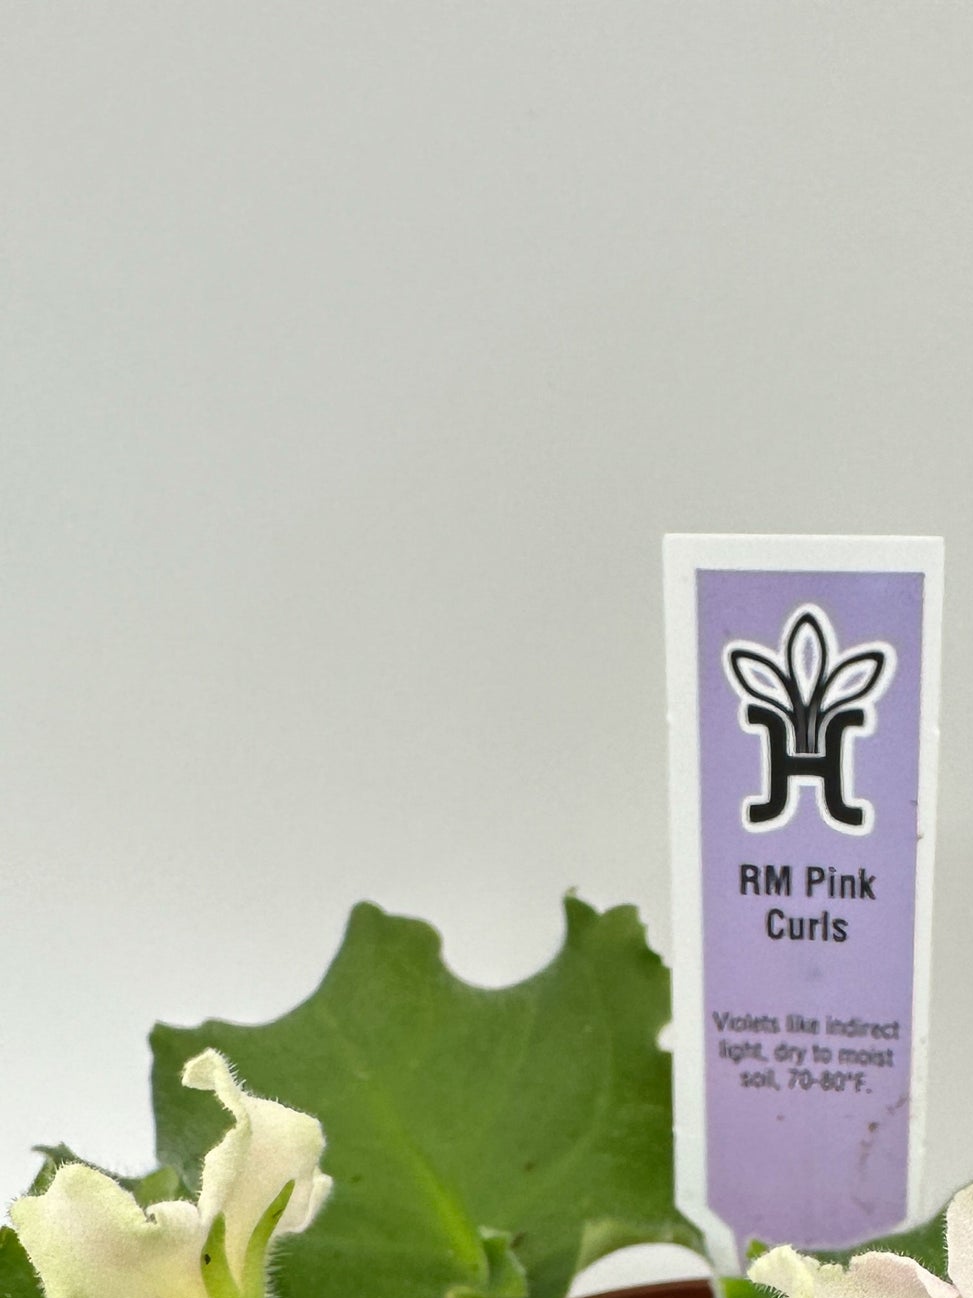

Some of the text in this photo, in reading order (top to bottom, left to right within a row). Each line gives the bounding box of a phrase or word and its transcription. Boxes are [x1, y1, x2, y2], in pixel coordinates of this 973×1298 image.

[740, 864, 876, 900] RM Pink
[767, 908, 848, 942] Curls
[713, 1011, 900, 1040] Violets like indirect
[774, 1041, 806, 1065] dry
[812, 1044, 832, 1064] to
[838, 1048, 893, 1067] moist
